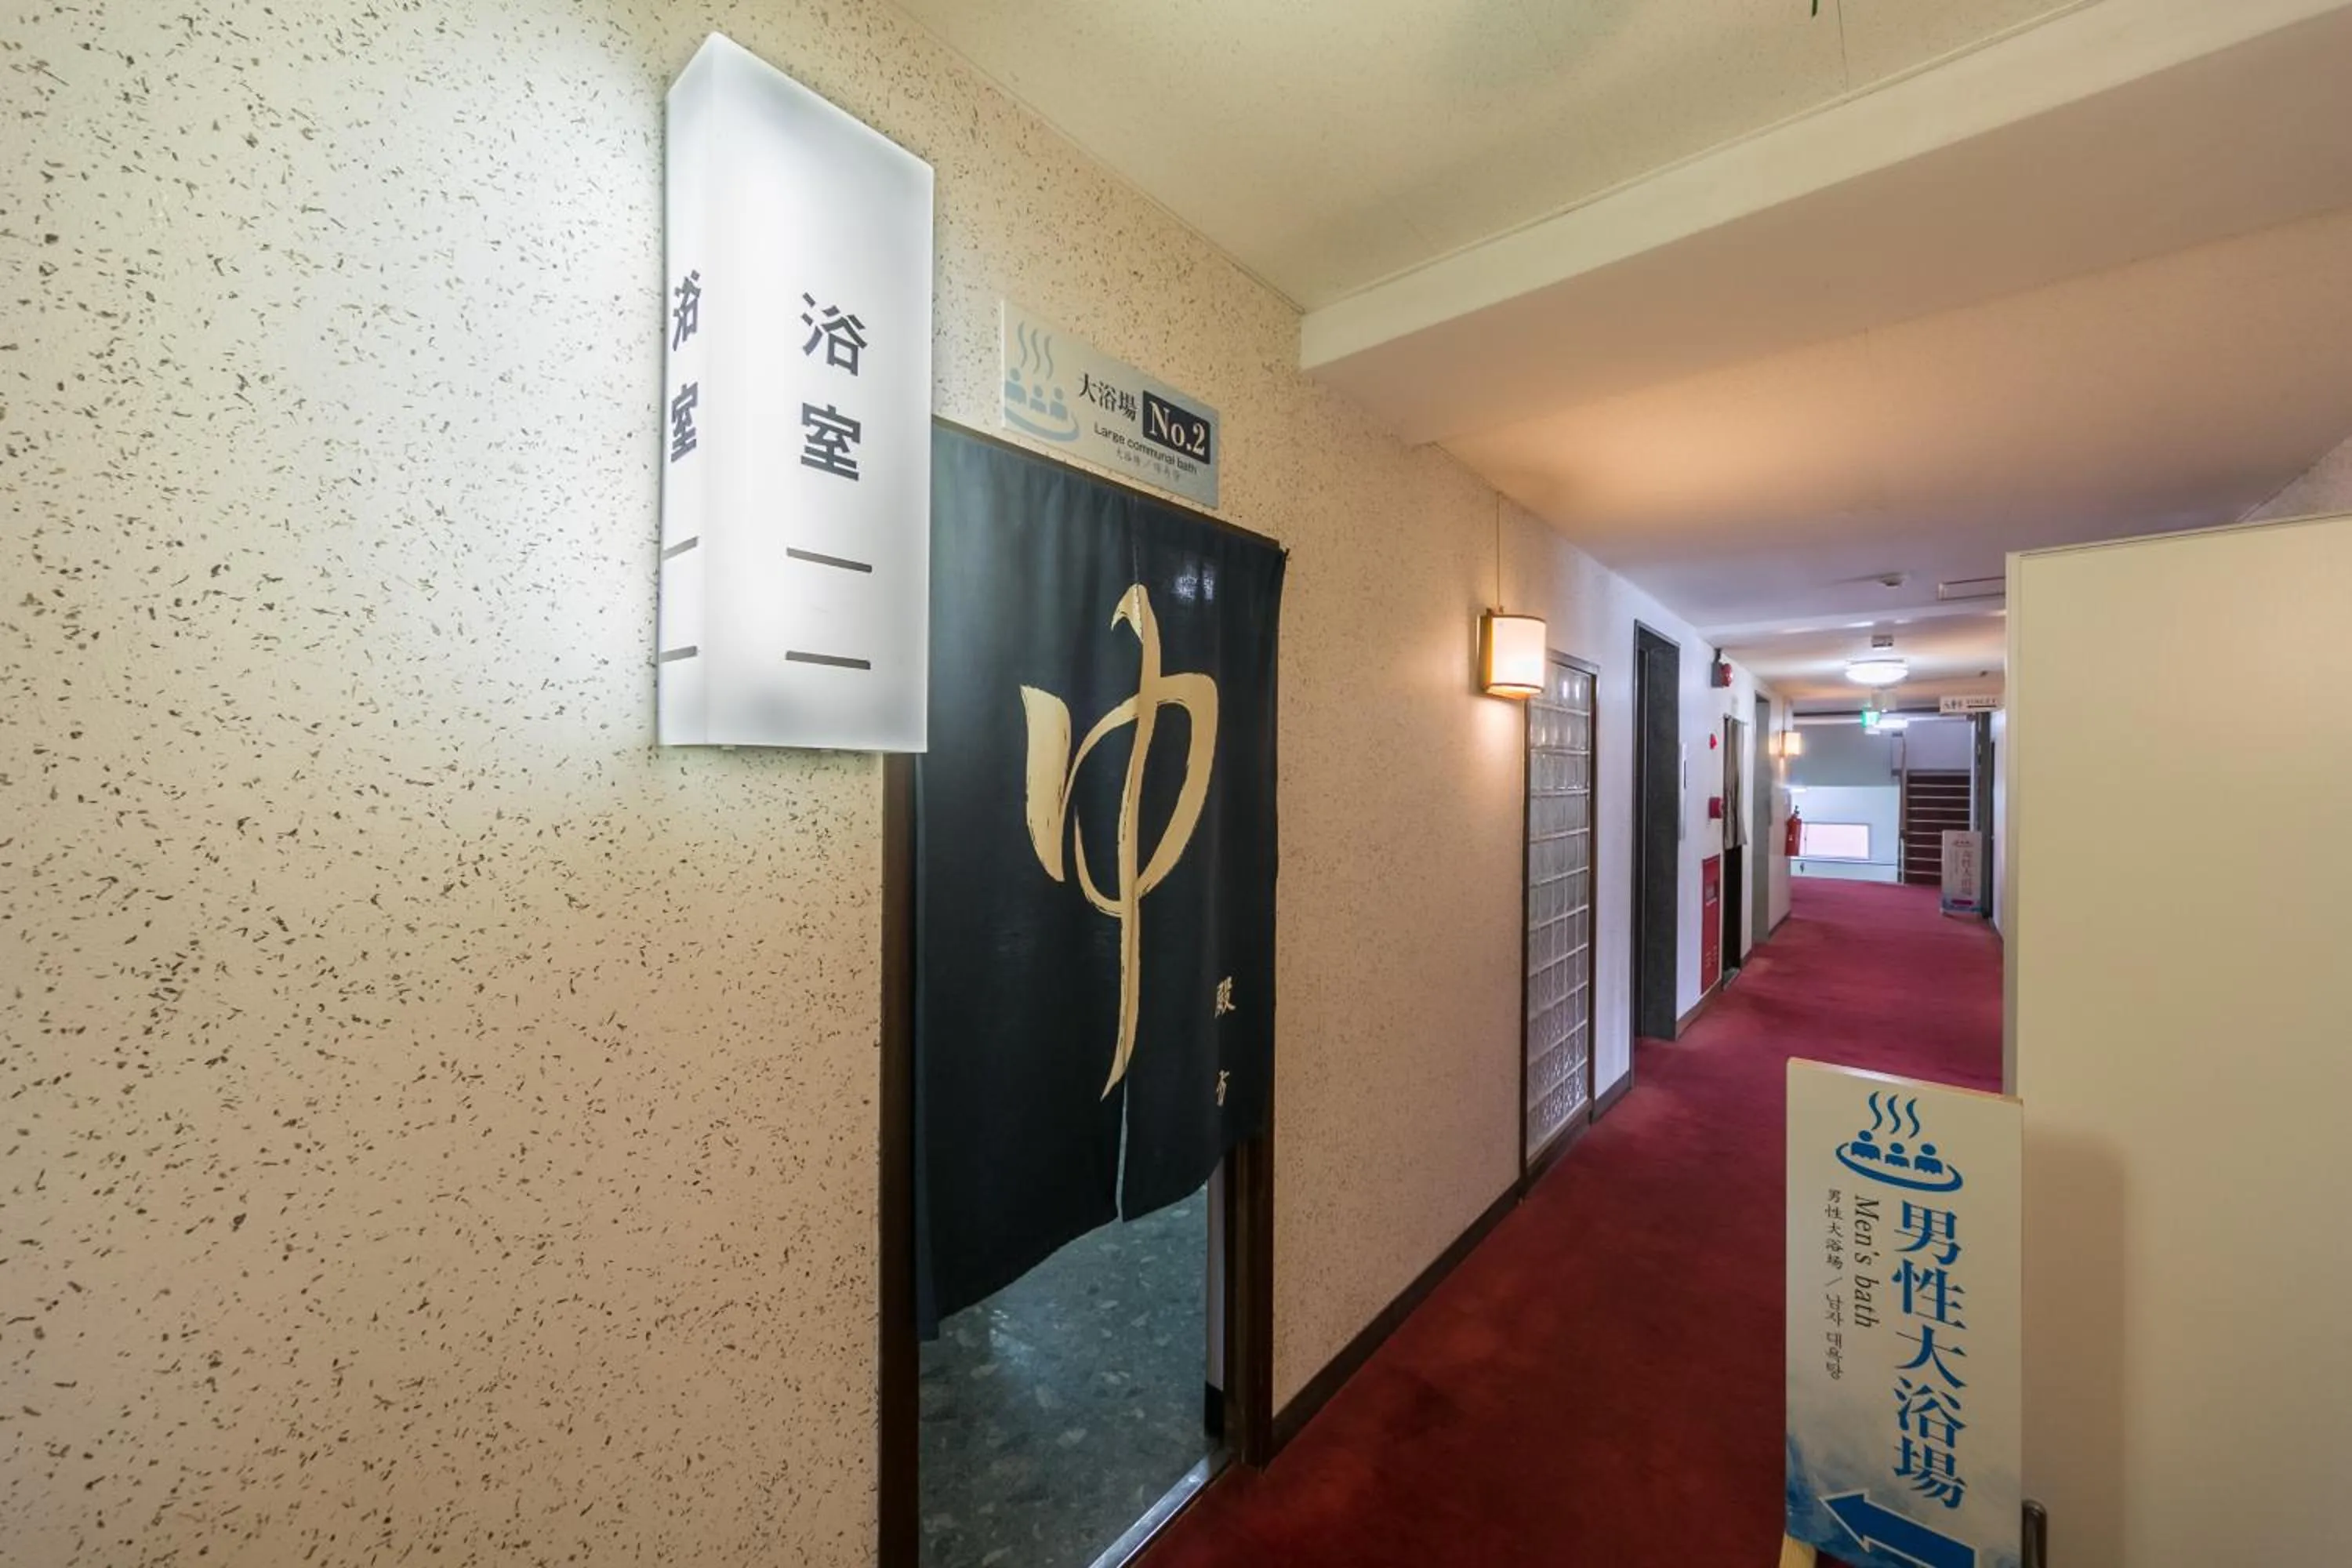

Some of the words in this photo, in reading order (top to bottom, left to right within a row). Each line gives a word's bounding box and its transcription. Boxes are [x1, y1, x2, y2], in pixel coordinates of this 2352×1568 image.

[1079, 372, 1138, 422] 大浴場
[1094, 422, 1126, 445] Large
[1127, 437, 1175, 465] communal
[1177, 458, 1197, 474] bath
[1149, 401, 1206, 456] No.2
[1020, 583, 1219, 1102] ゆ
[1854, 1194, 1880, 1266] Men's
[1854, 1274, 1880, 1328] bath
[1891, 1200, 1968, 1509] 男性大浴場
